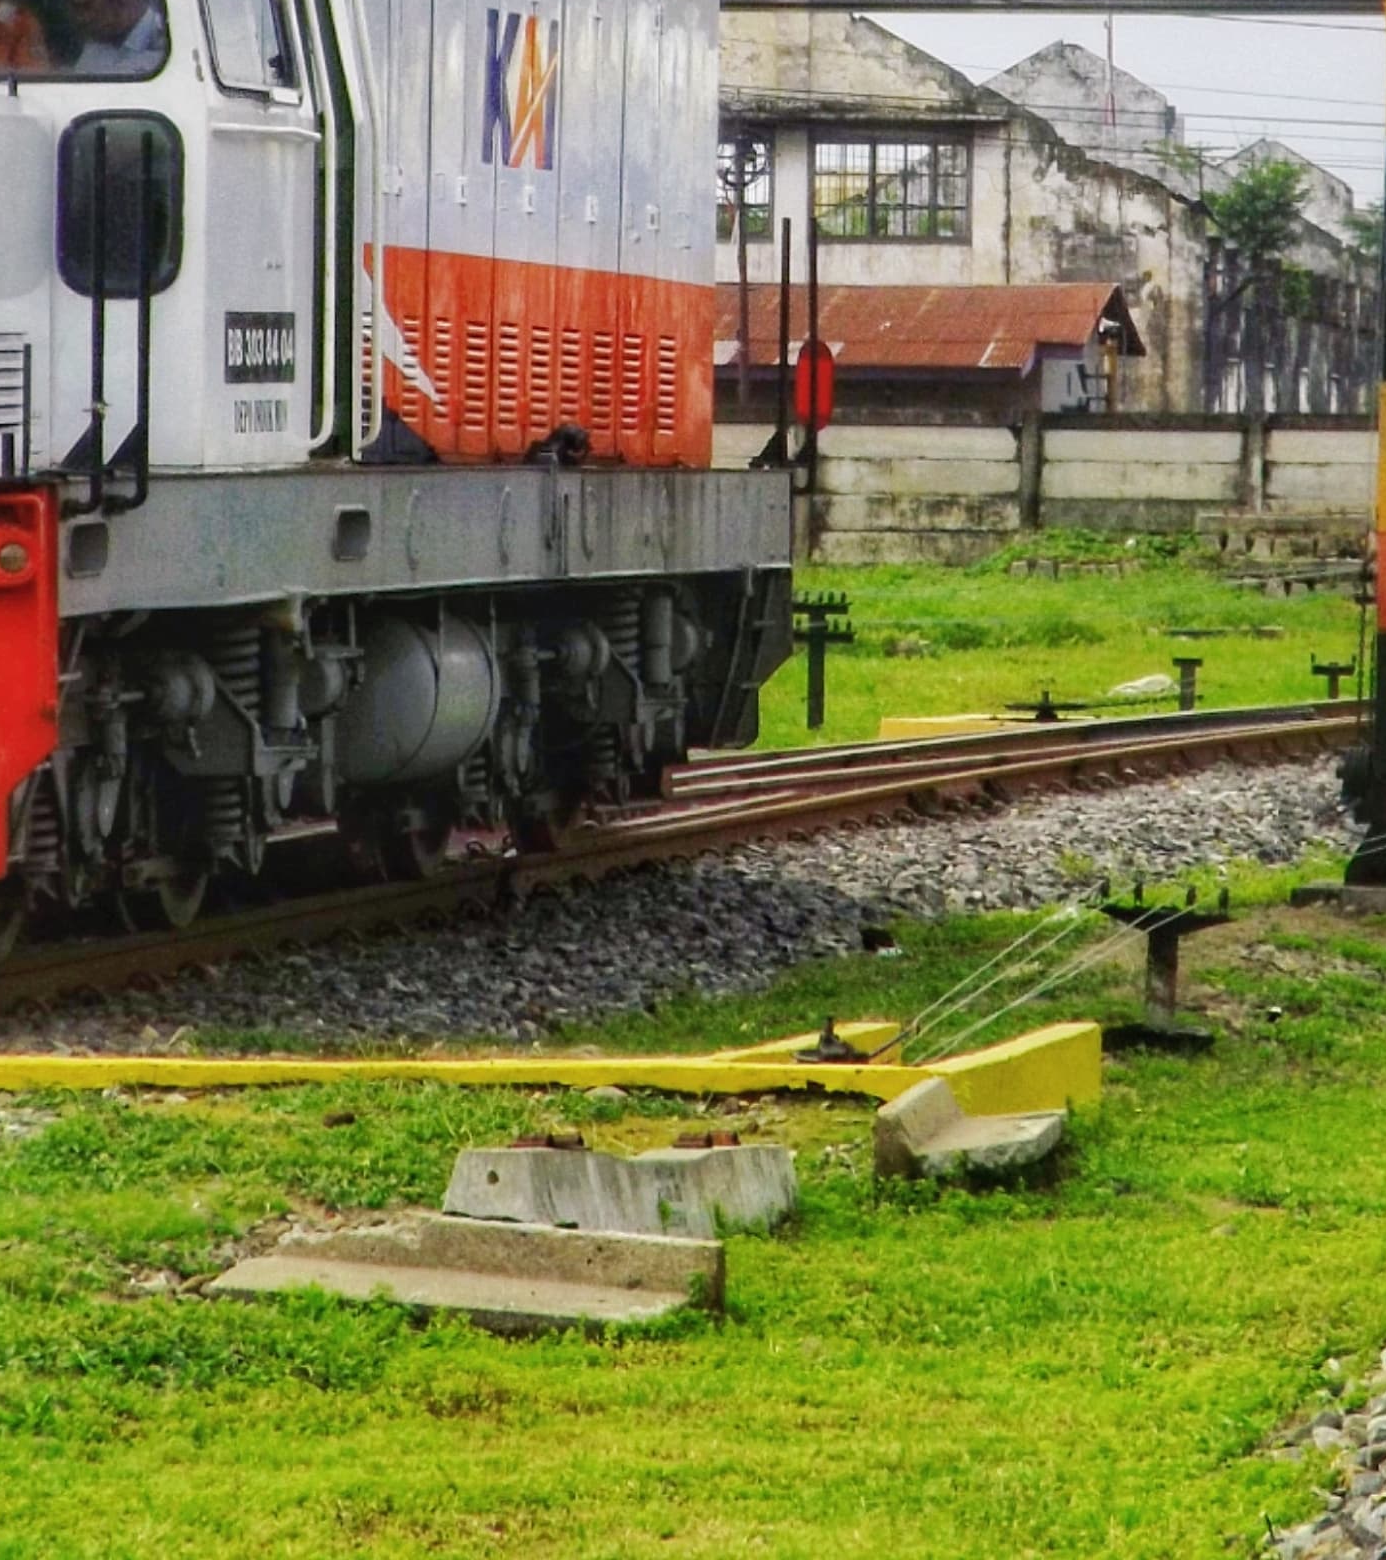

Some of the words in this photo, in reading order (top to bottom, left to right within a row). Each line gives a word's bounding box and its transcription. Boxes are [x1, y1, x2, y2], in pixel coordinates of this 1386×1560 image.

[481, 7, 560, 171] KAI
[228, 328, 243, 367] BB
[245, 328, 264, 367] 303
[280, 328, 294, 366] 04
